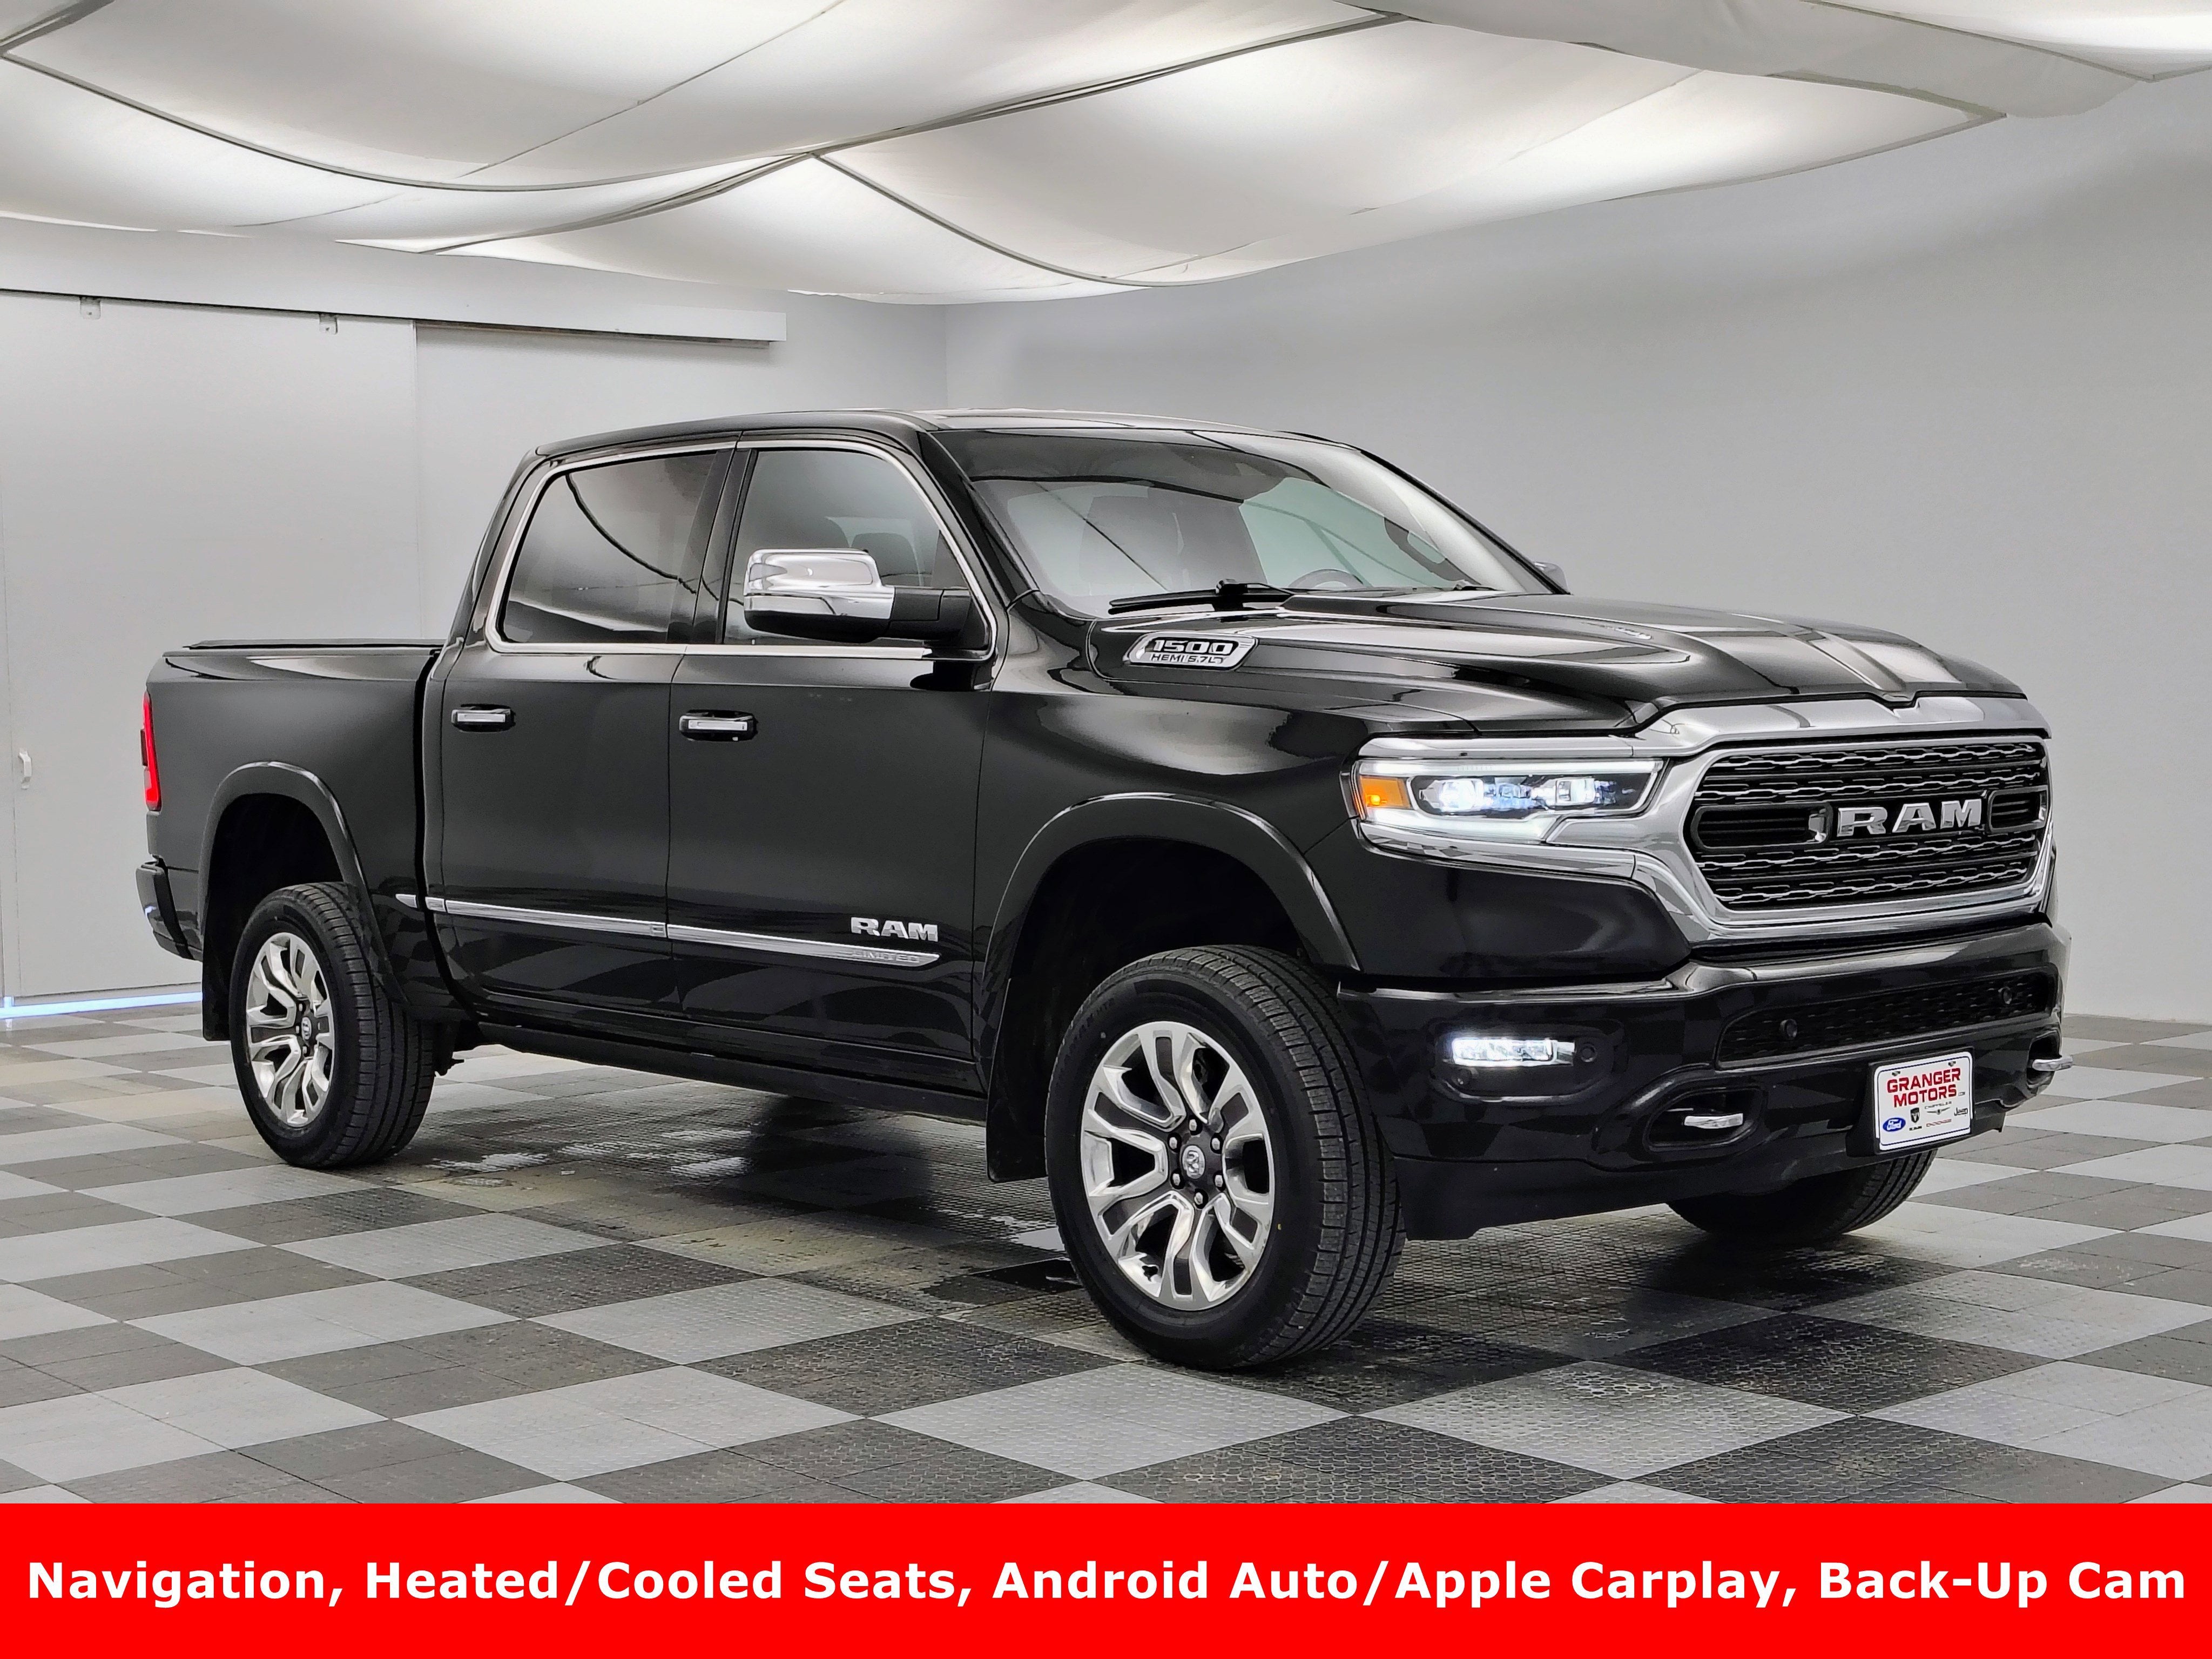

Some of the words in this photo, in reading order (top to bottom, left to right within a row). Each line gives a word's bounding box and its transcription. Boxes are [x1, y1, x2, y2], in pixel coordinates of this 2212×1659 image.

[1151, 653, 1184, 663] HEMI
[1152, 639, 1233, 655] 1500
[1837, 798, 1982, 837] RAM
[851, 917, 938, 942] RAM
[1887, 1067, 1961, 1094] GRANGER
[1894, 1084, 1957, 1108] MOTORS
